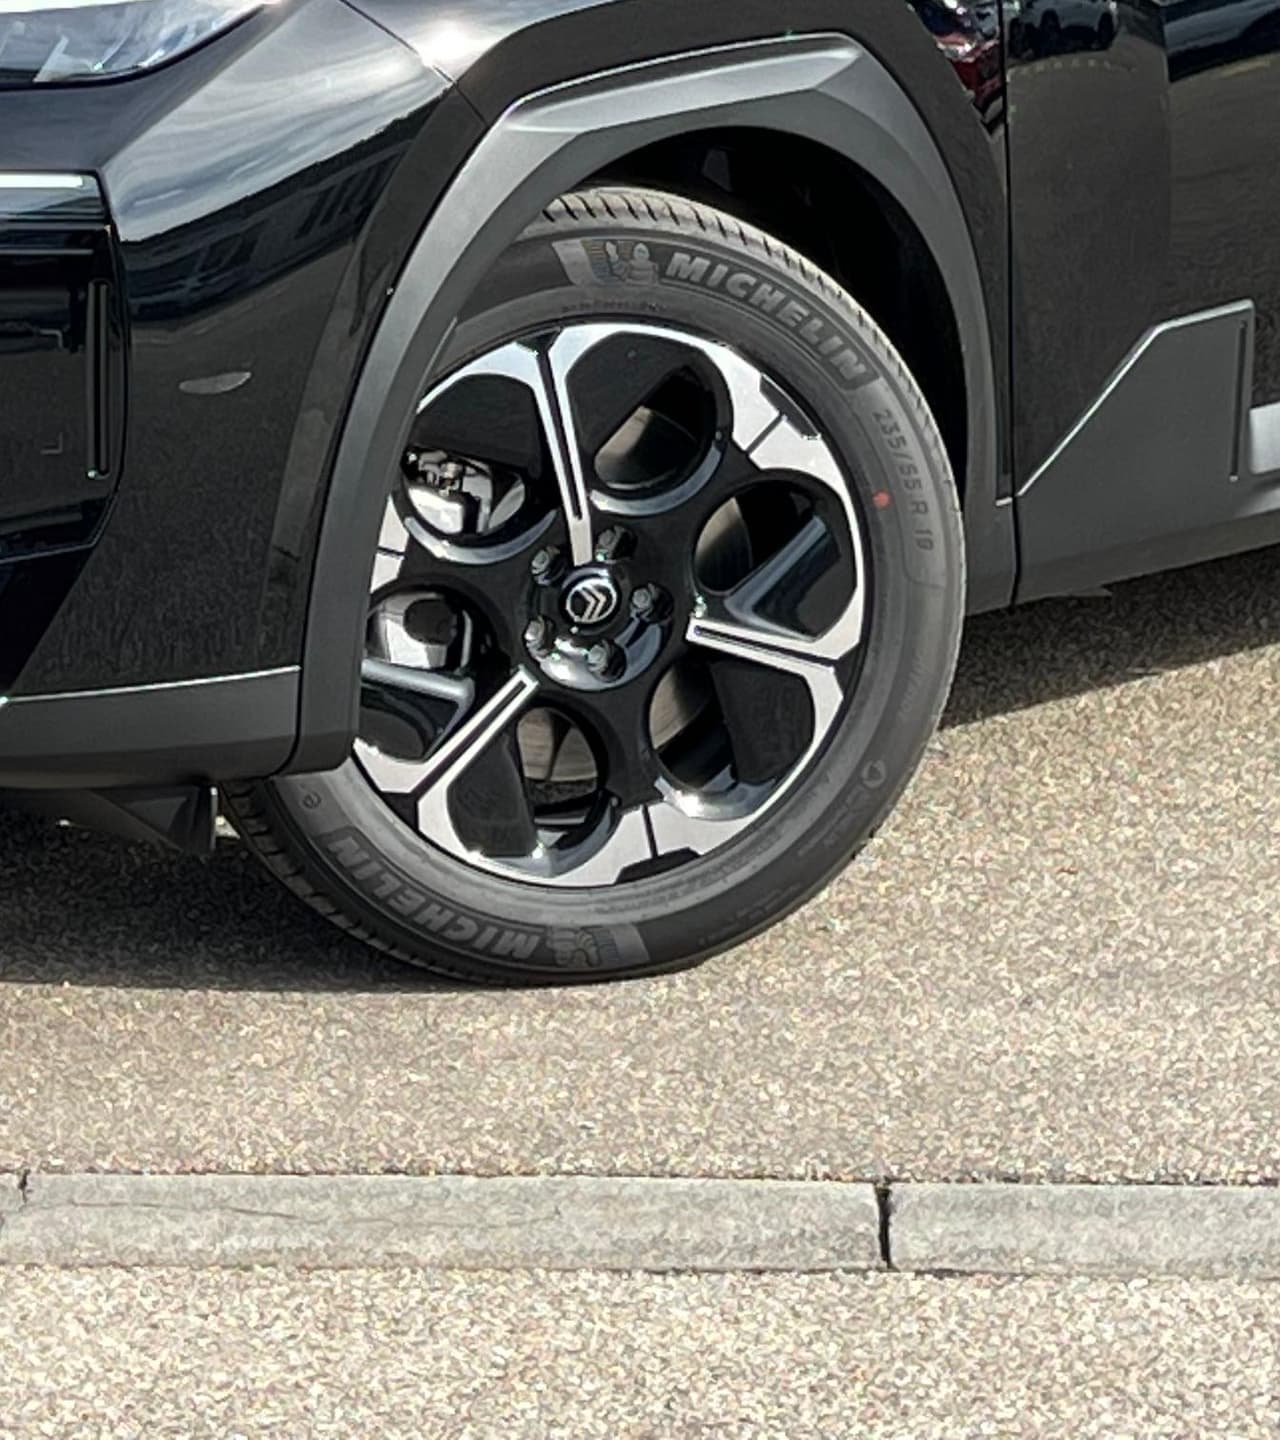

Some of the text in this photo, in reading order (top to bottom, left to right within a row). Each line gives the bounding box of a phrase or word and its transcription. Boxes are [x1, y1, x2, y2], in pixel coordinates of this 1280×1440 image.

[666, 251, 867, 381] MICHELIN
[873, 409, 923, 491] 235/55
[327, 835, 546, 959] MICHELIN
